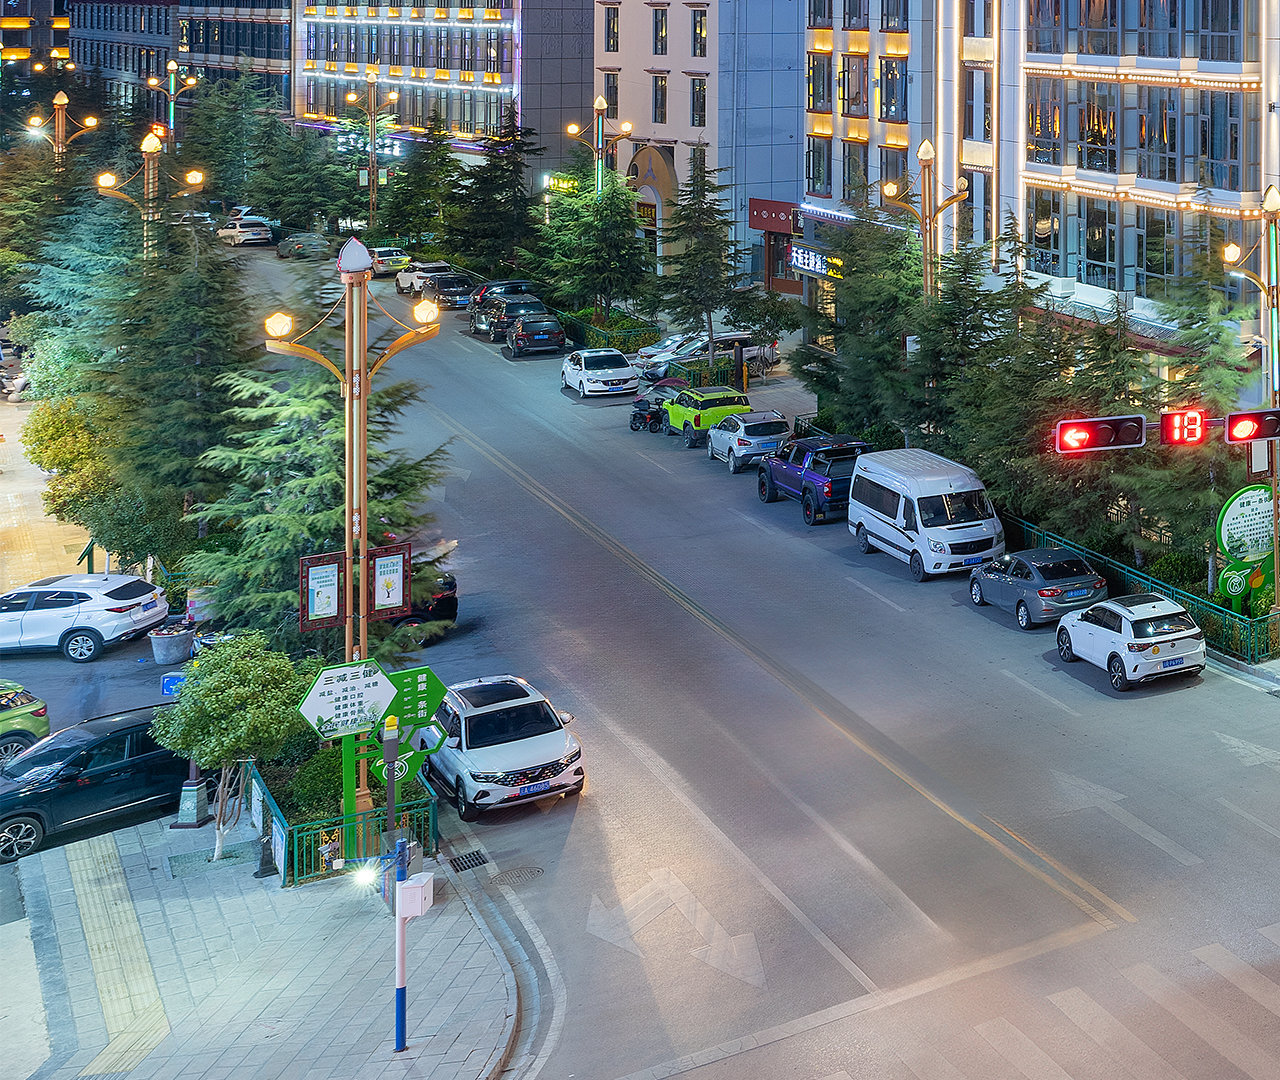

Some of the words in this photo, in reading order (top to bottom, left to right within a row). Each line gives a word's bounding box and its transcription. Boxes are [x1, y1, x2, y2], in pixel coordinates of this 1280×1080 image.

[1174, 411, 1201, 441] 18
[323, 669, 374, 686] 三减三健
[417, 673, 428, 718] 健康一条街
